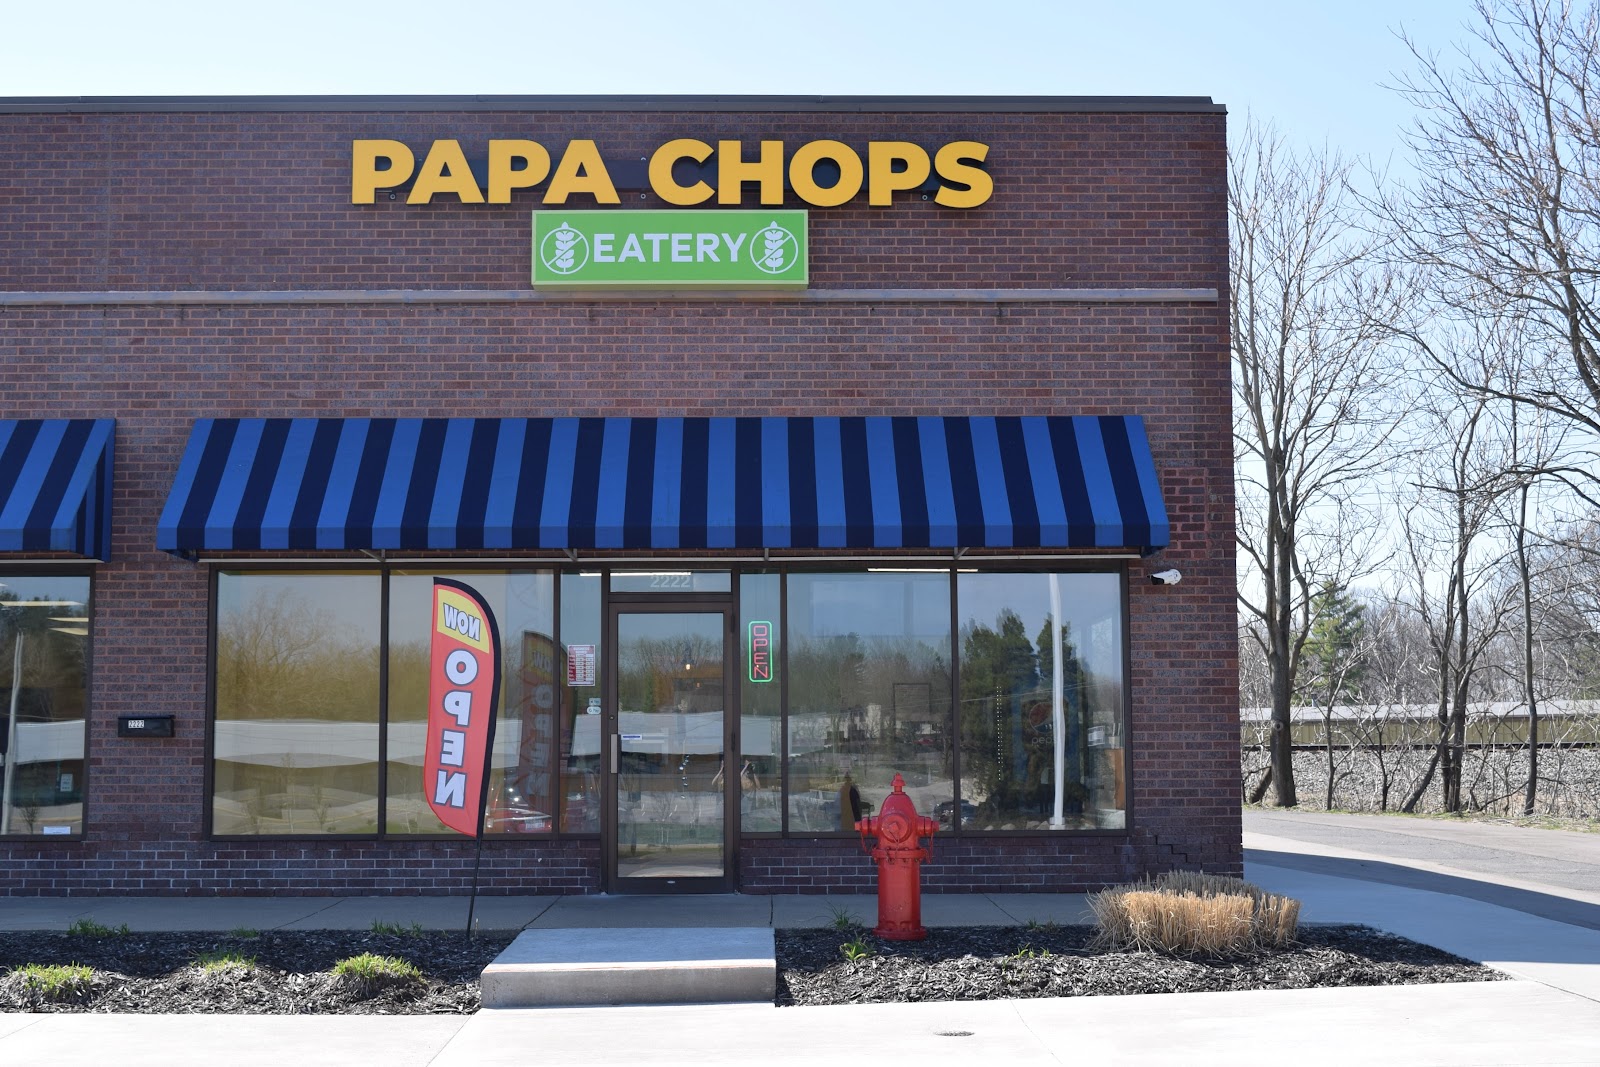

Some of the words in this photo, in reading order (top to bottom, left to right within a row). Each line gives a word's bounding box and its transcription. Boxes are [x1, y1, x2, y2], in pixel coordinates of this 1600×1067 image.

[351, 139, 621, 206] PAPA
[647, 138, 995, 209] CHOPS
[592, 233, 747, 264] EATERY
[650, 574, 691, 588] 2222
[753, 625, 768, 679] OPEN
